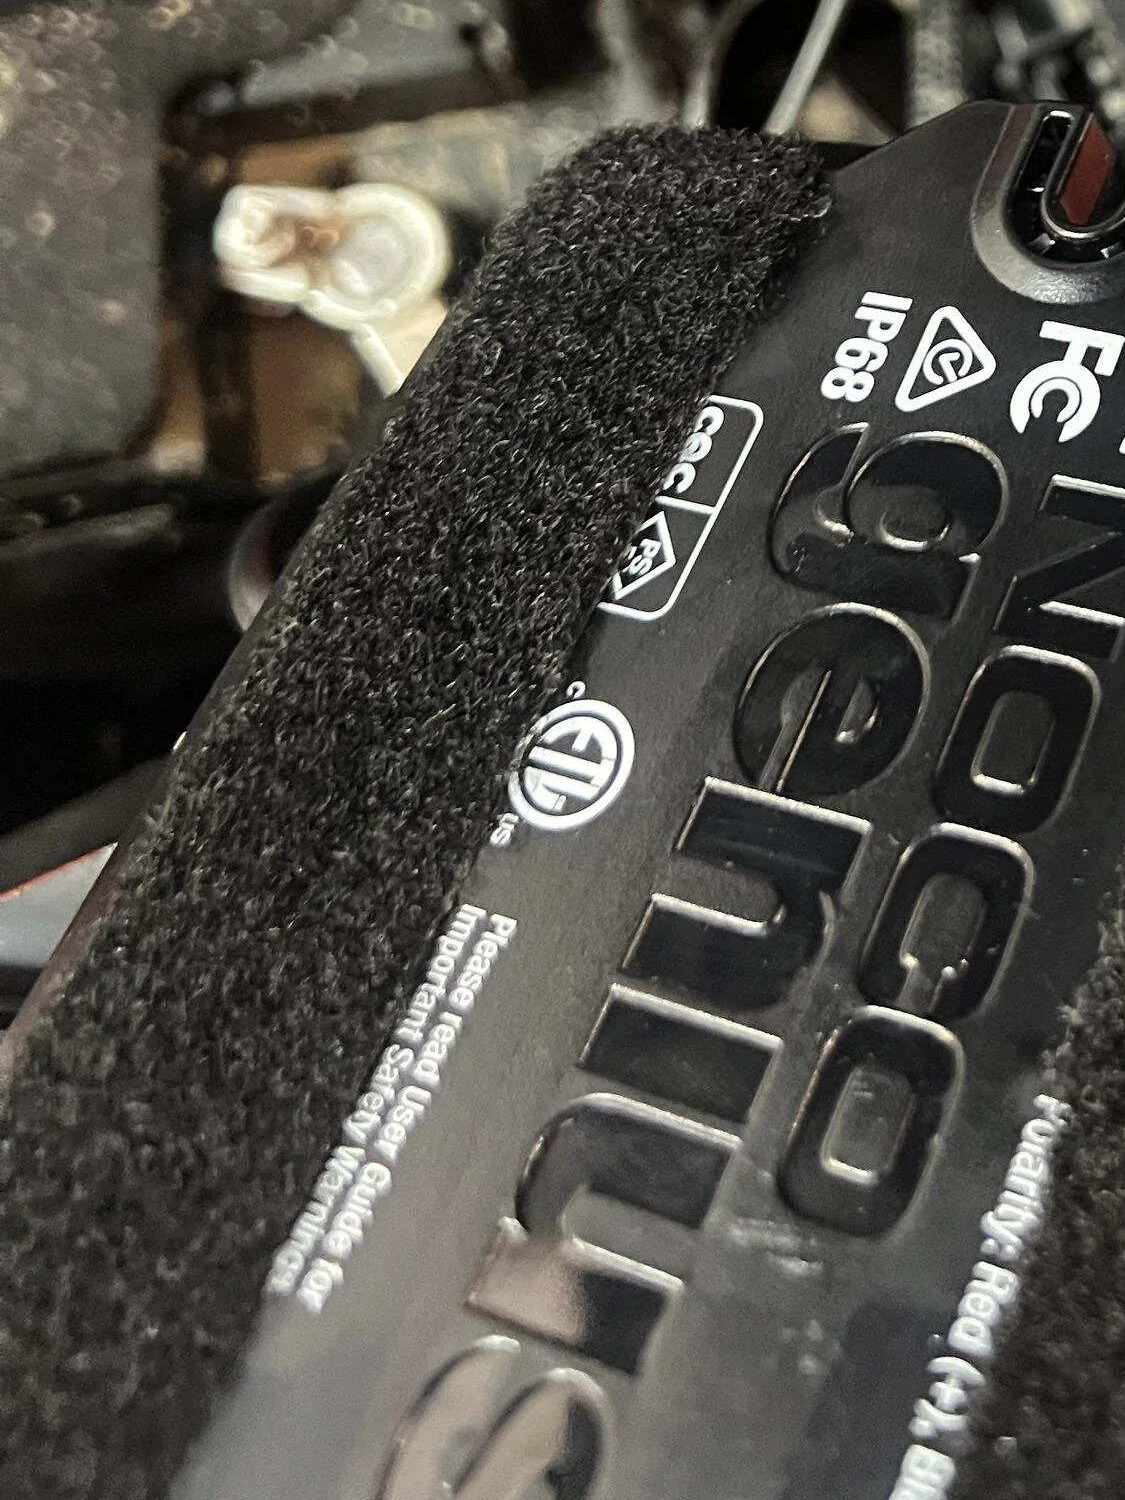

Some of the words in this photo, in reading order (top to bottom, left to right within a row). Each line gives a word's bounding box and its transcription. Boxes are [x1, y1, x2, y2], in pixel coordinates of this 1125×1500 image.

[820, 291, 914, 403] IP68
[374, 421, 1009, 1500] genius
[395, 903, 487, 1043] Important
[449, 912, 518, 1011] Please
[341, 1043, 415, 1145] Safety
[414, 1011, 465, 1088] read
[374, 1084, 432, 1162] User
[321, 1162, 392, 1260] Guide
[297, 1257, 344, 1315] for
[948, 1260, 1022, 1360] Red
